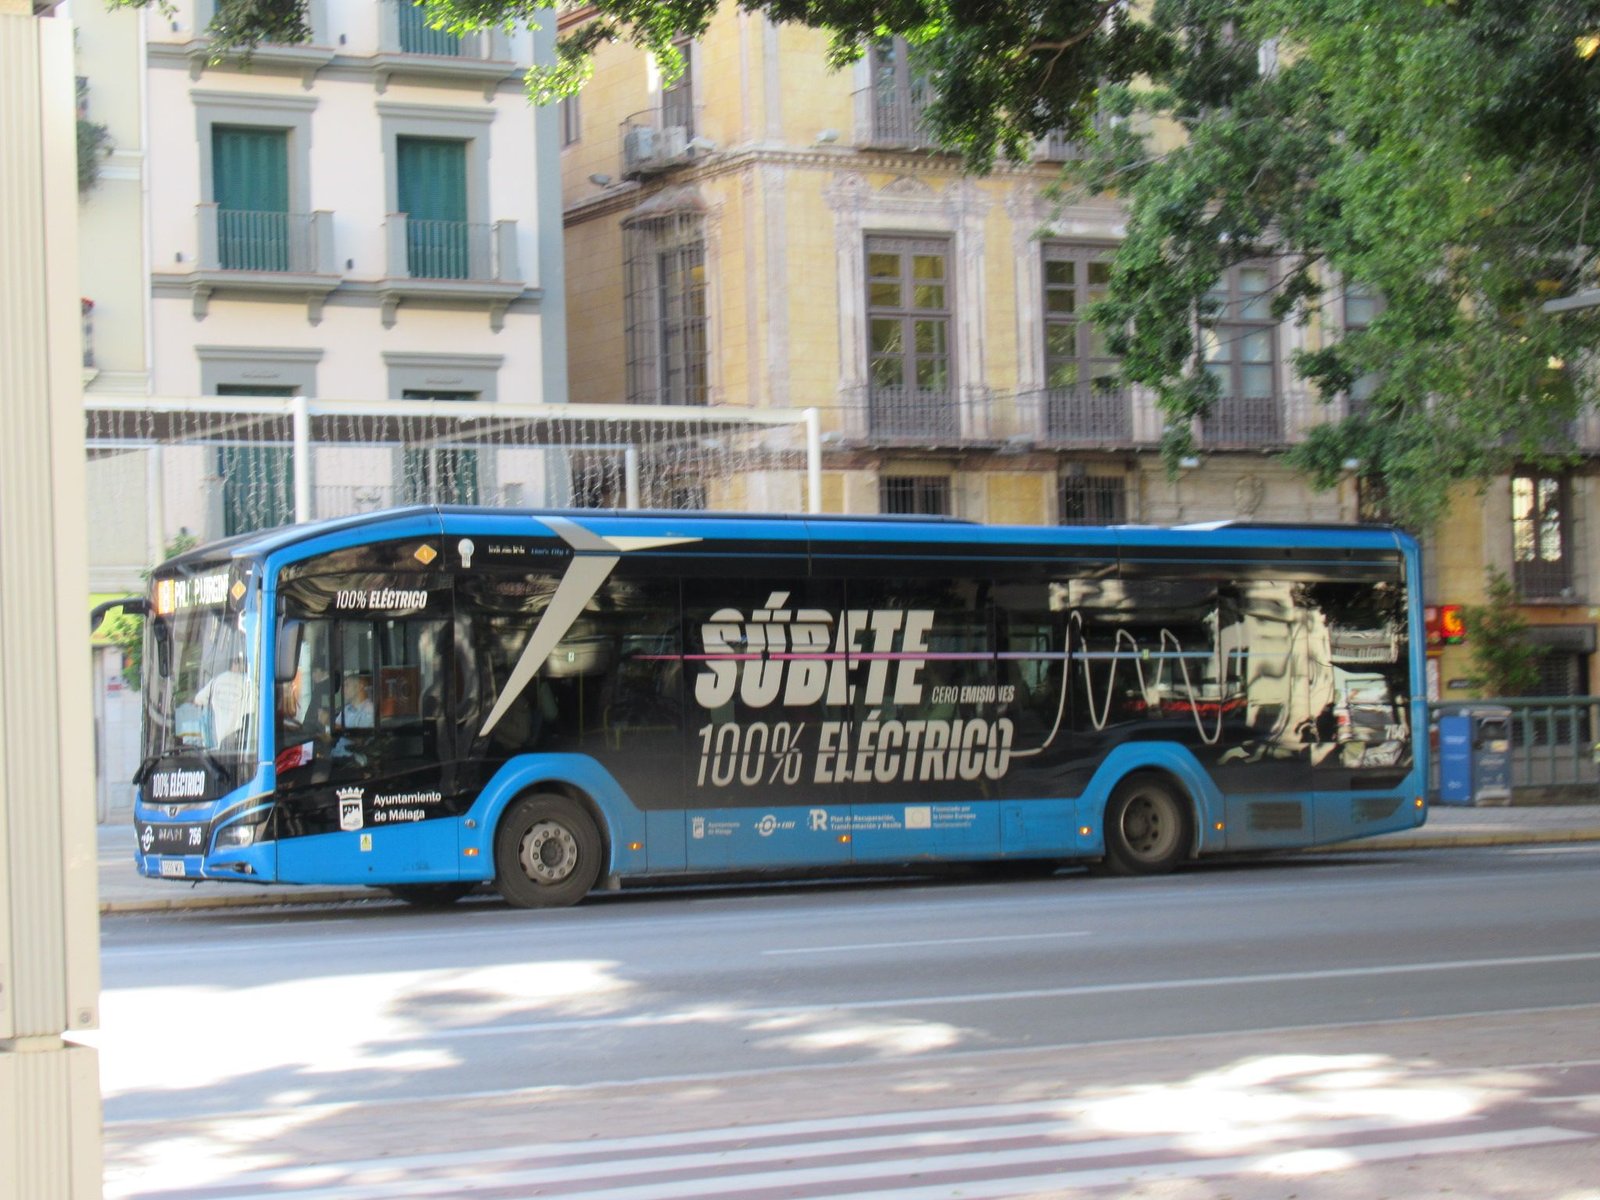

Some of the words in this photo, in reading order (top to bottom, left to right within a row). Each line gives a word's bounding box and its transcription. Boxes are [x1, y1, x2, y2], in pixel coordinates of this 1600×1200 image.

[336, 590, 367, 609] 100%
[368, 587, 428, 609] ELÉCTRICO
[695, 591, 934, 708] SÚBETE
[931, 685, 959, 704] CERO
[697, 720, 804, 787] 100%
[813, 710, 1014, 783] ELÉCTRICO
[153, 773, 169, 798] 100%
[169, 768, 206, 798] ELÉCTRICO
[373, 791, 442, 807] Ayuntamiento
[374, 810, 387, 822] de
[389, 808, 426, 822] Málaga
[188, 826, 202, 846] 756
